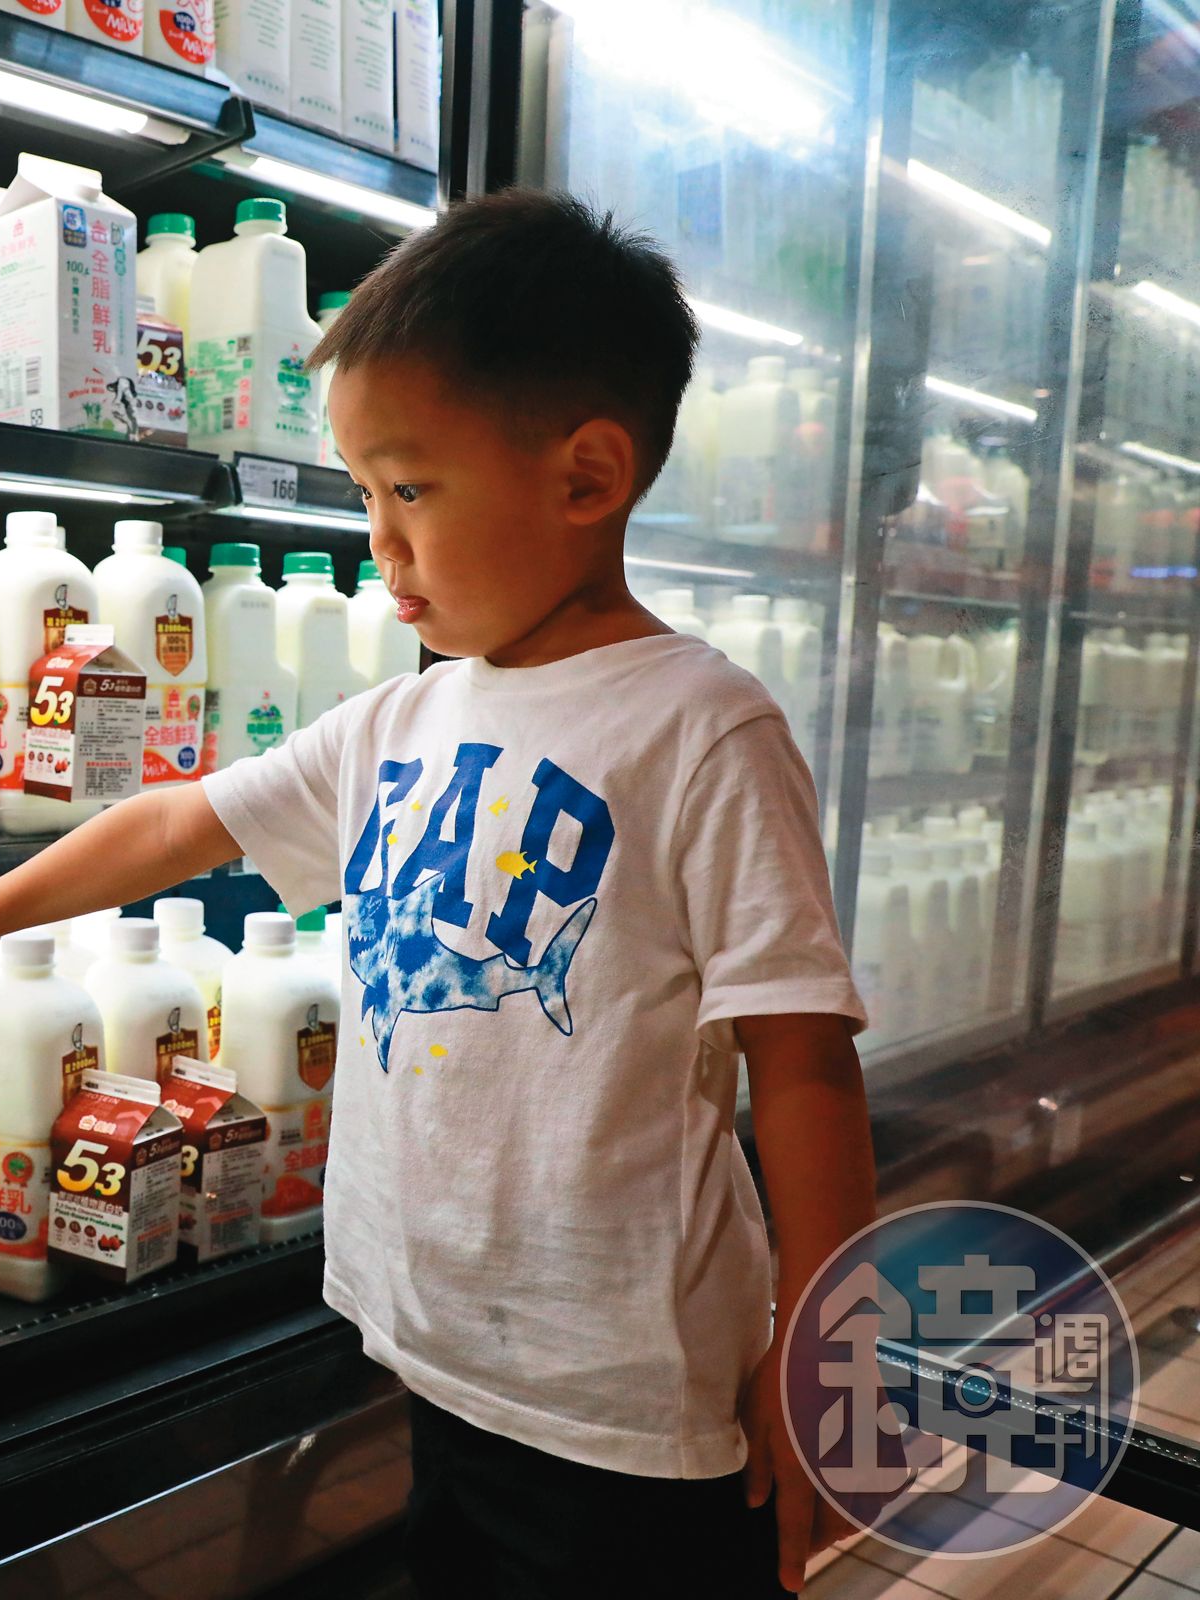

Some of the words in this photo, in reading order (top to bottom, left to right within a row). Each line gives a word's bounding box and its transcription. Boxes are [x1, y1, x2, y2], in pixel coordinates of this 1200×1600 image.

[91, 249, 112, 354] 全脂鮮乳
[272, 479, 296, 500] 166
[144, 725, 198, 746] 全脂鮮乳
